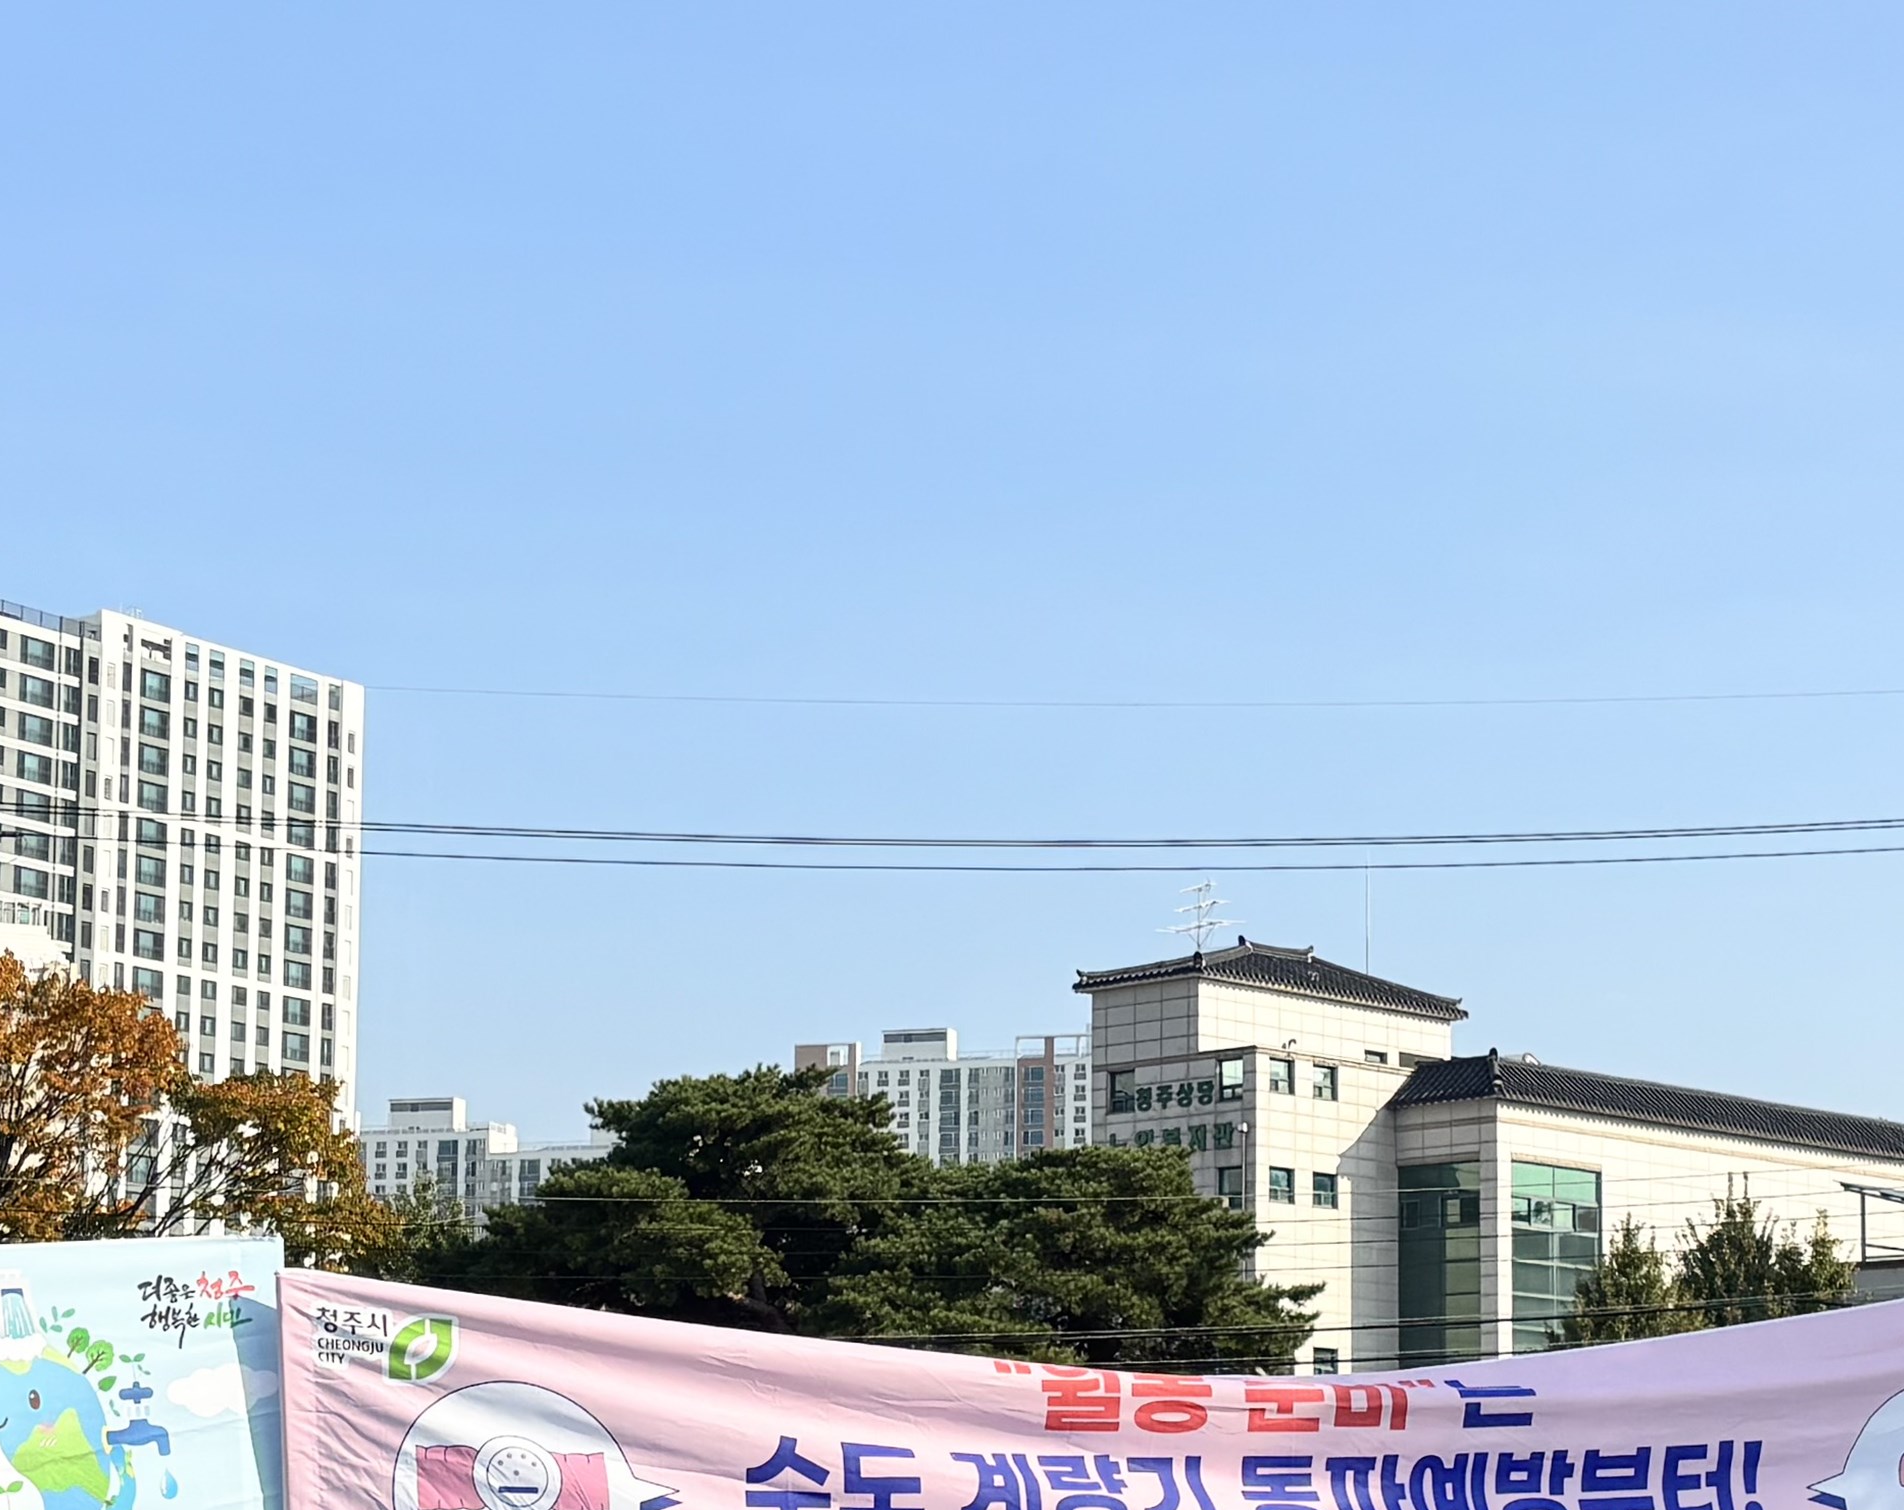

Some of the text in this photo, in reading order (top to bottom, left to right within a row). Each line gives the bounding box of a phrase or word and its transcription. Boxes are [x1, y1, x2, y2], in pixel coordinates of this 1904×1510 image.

[1136, 1080, 1215, 1112] 청주상당
[196, 1270, 255, 1299] 청주
[141, 1302, 252, 1349] 행복한 시민
[316, 1307, 387, 1337] 청주시
[318, 1337, 384, 1354] CHEONGJU
[319, 1352, 344, 1364] CITY
